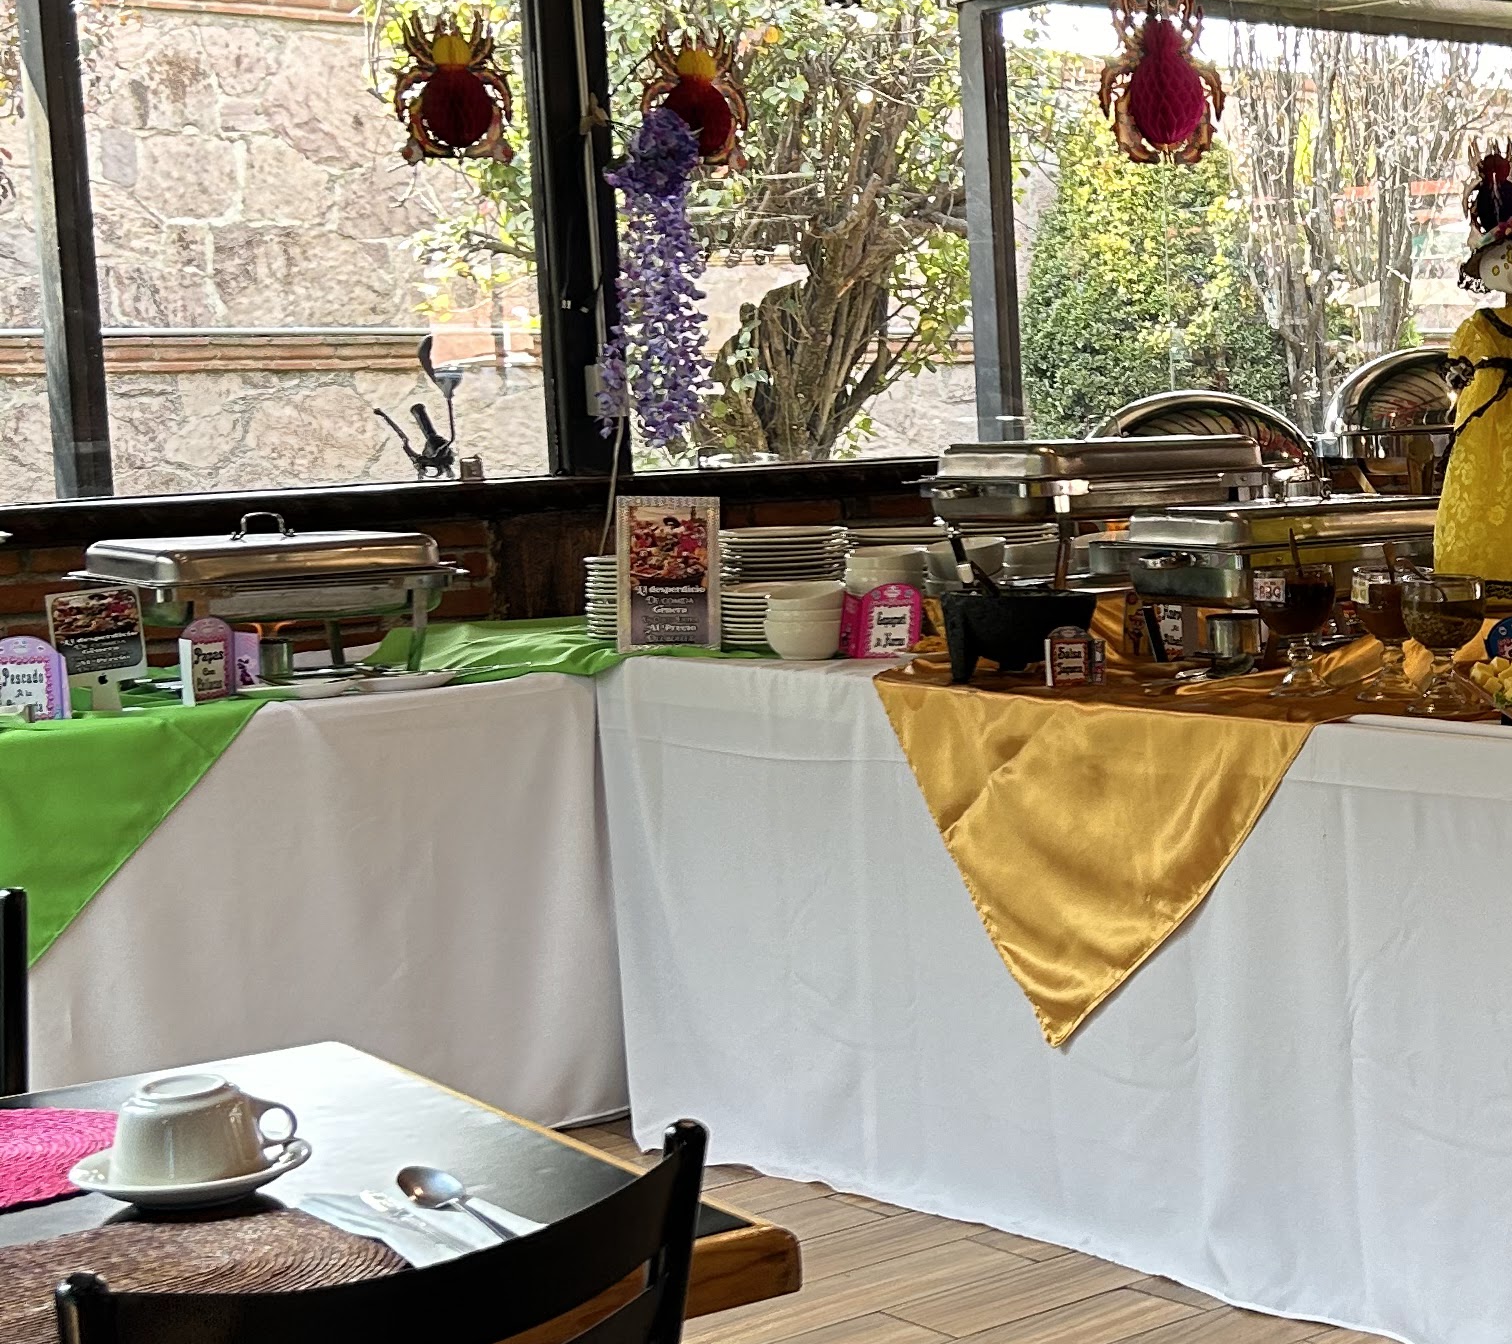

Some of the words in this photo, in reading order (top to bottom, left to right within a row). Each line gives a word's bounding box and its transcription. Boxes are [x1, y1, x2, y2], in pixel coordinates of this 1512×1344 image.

[648, 584, 706, 594] desperdicio
[194, 647, 224, 665] Papas
[1, 667, 44, 687] Pescado
